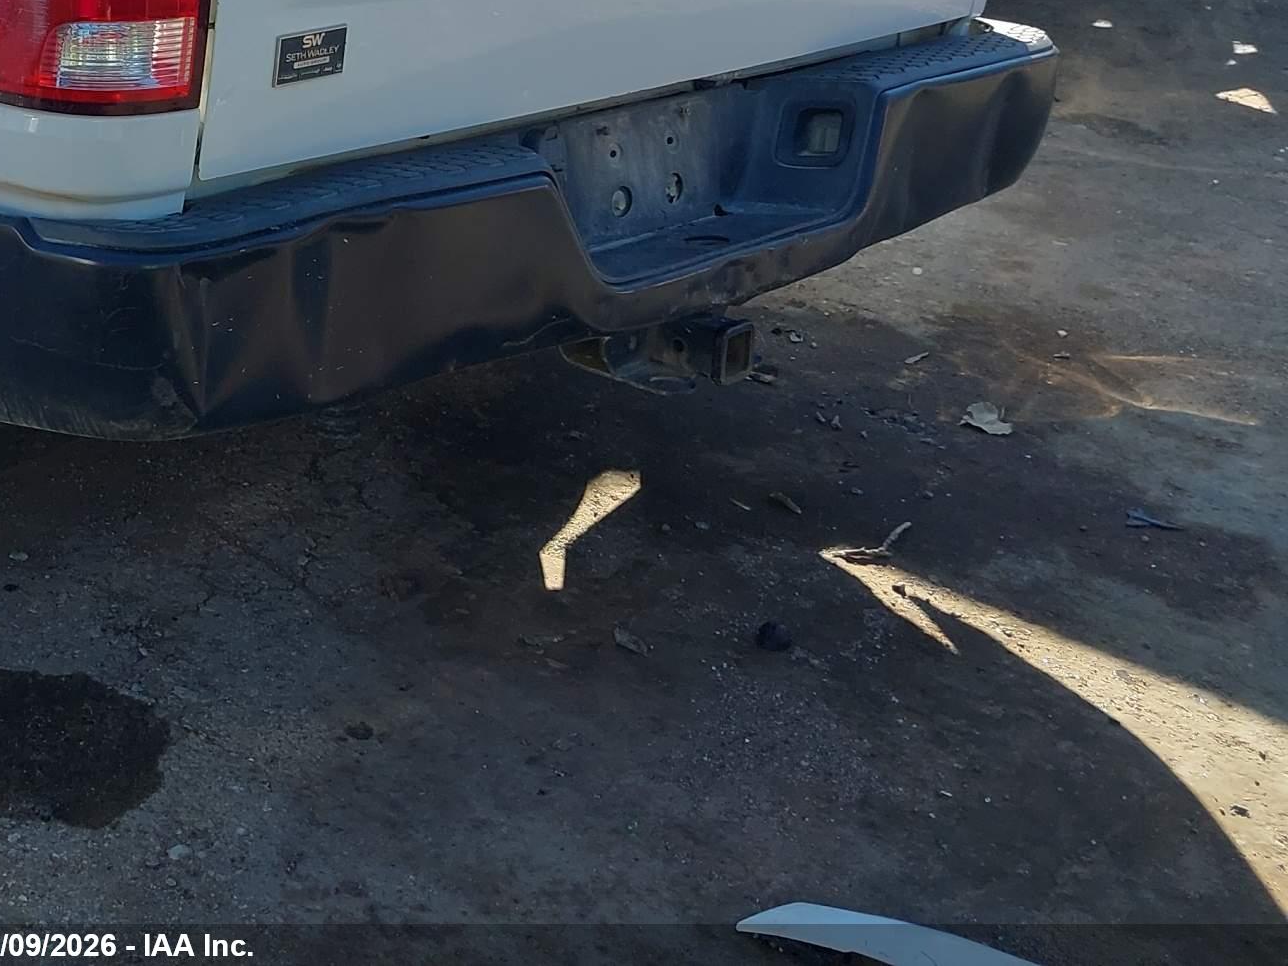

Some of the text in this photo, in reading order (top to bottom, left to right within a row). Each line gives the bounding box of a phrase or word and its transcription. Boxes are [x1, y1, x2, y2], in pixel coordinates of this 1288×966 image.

[302, 33, 326, 48] SW
[286, 45, 340, 62] SETH WADLEY
